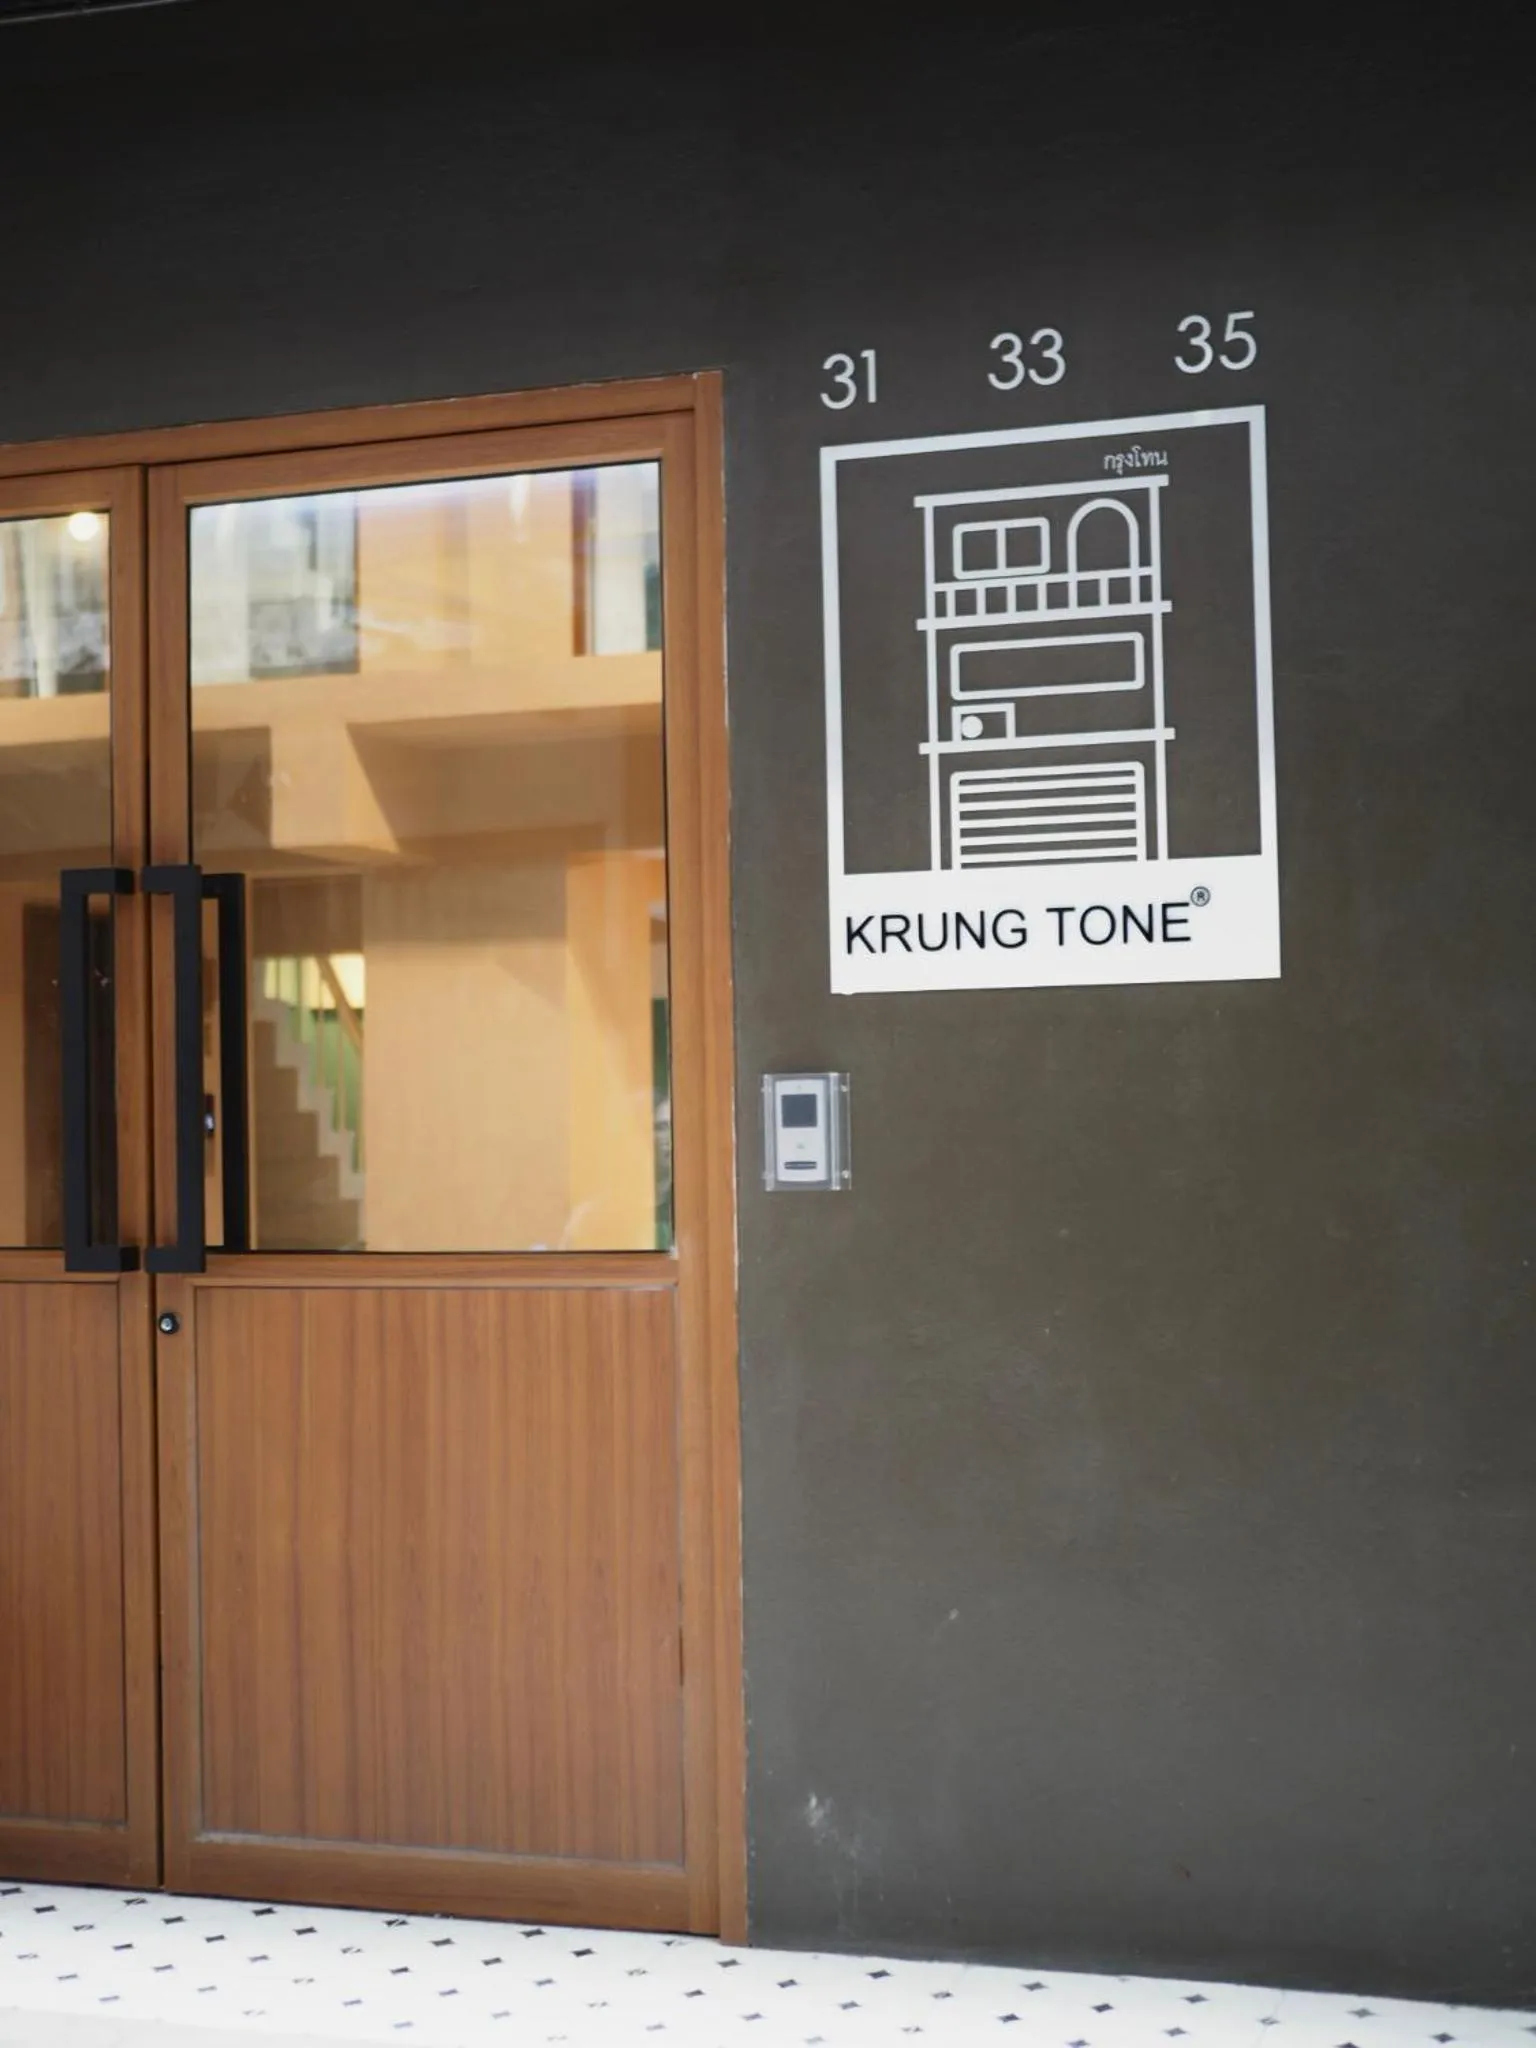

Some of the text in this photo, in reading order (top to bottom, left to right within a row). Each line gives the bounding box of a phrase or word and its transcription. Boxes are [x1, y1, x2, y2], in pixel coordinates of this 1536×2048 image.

[820, 311, 1257, 410] 31 33 35
[1103, 444, 1169, 475] กรุงโทน
[845, 908, 1028, 955] KRUNG
